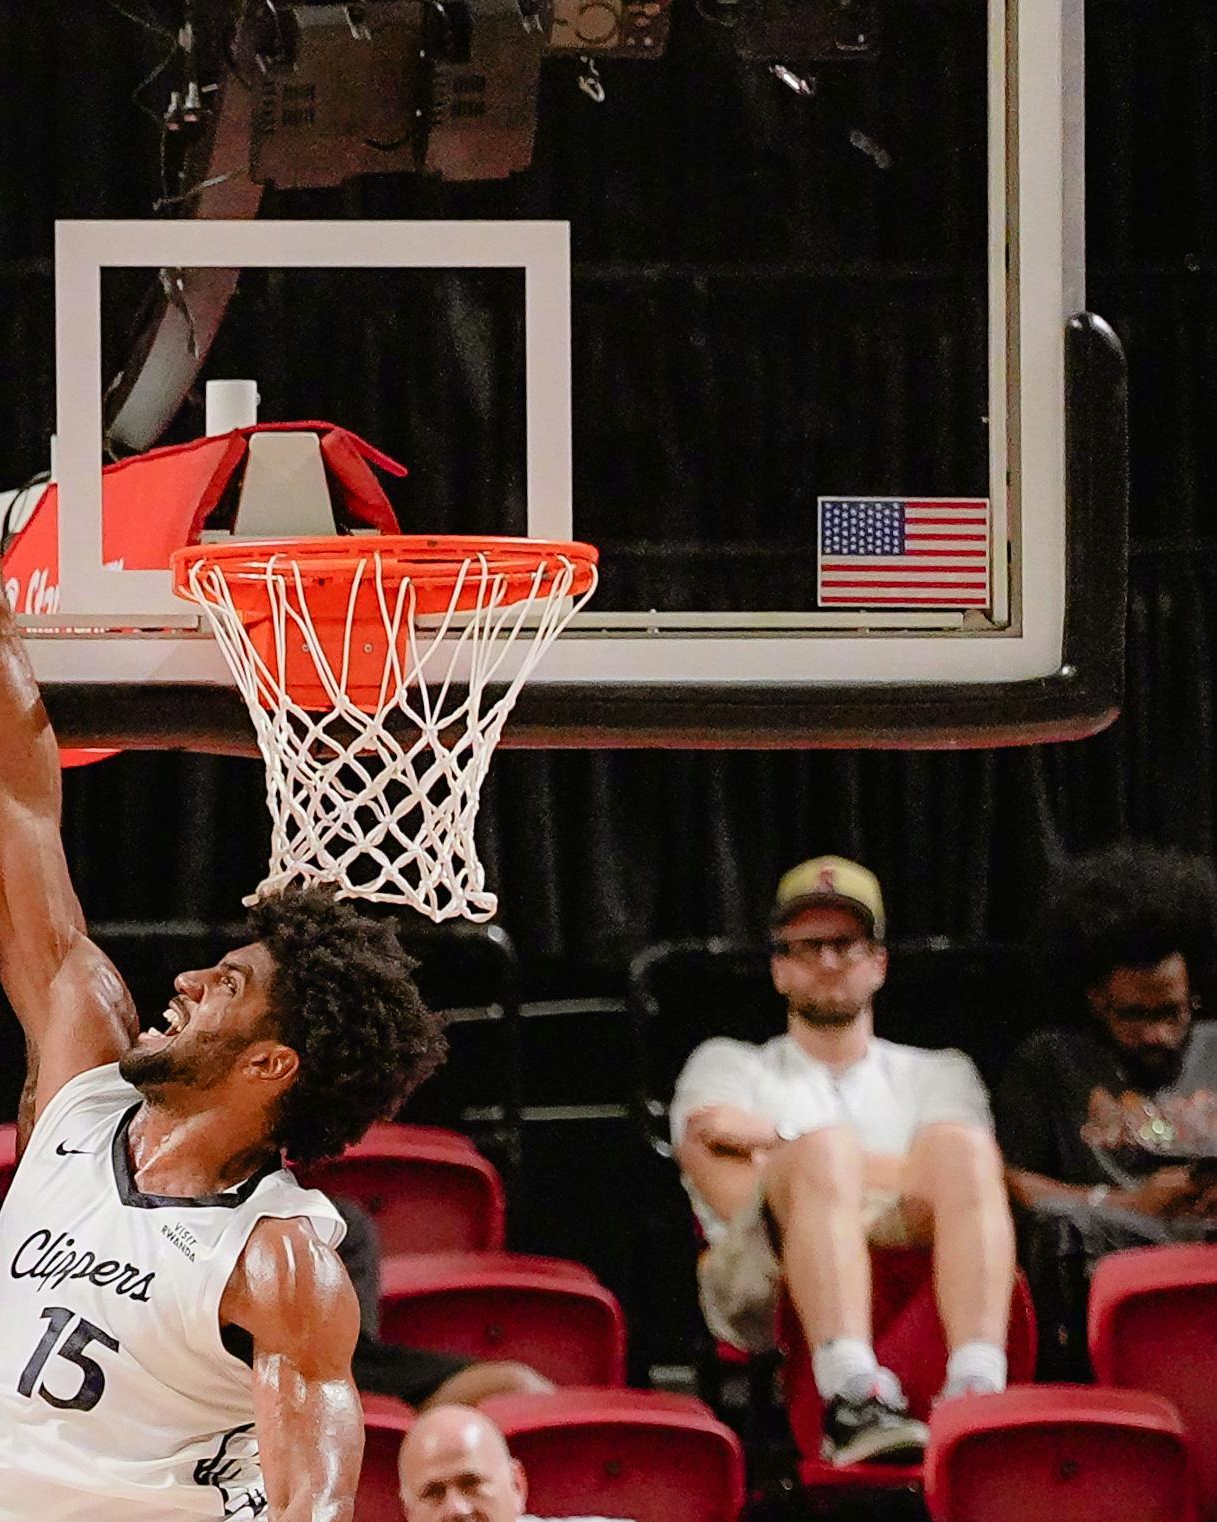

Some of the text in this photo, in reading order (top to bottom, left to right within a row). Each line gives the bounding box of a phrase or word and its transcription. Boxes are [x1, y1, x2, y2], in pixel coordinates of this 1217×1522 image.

[161, 1225, 195, 1263] RWANDA
[174, 1222, 197, 1246] VISIT
[10, 1229, 155, 1302] Clippers
[17, 1306, 119, 1411] 15
